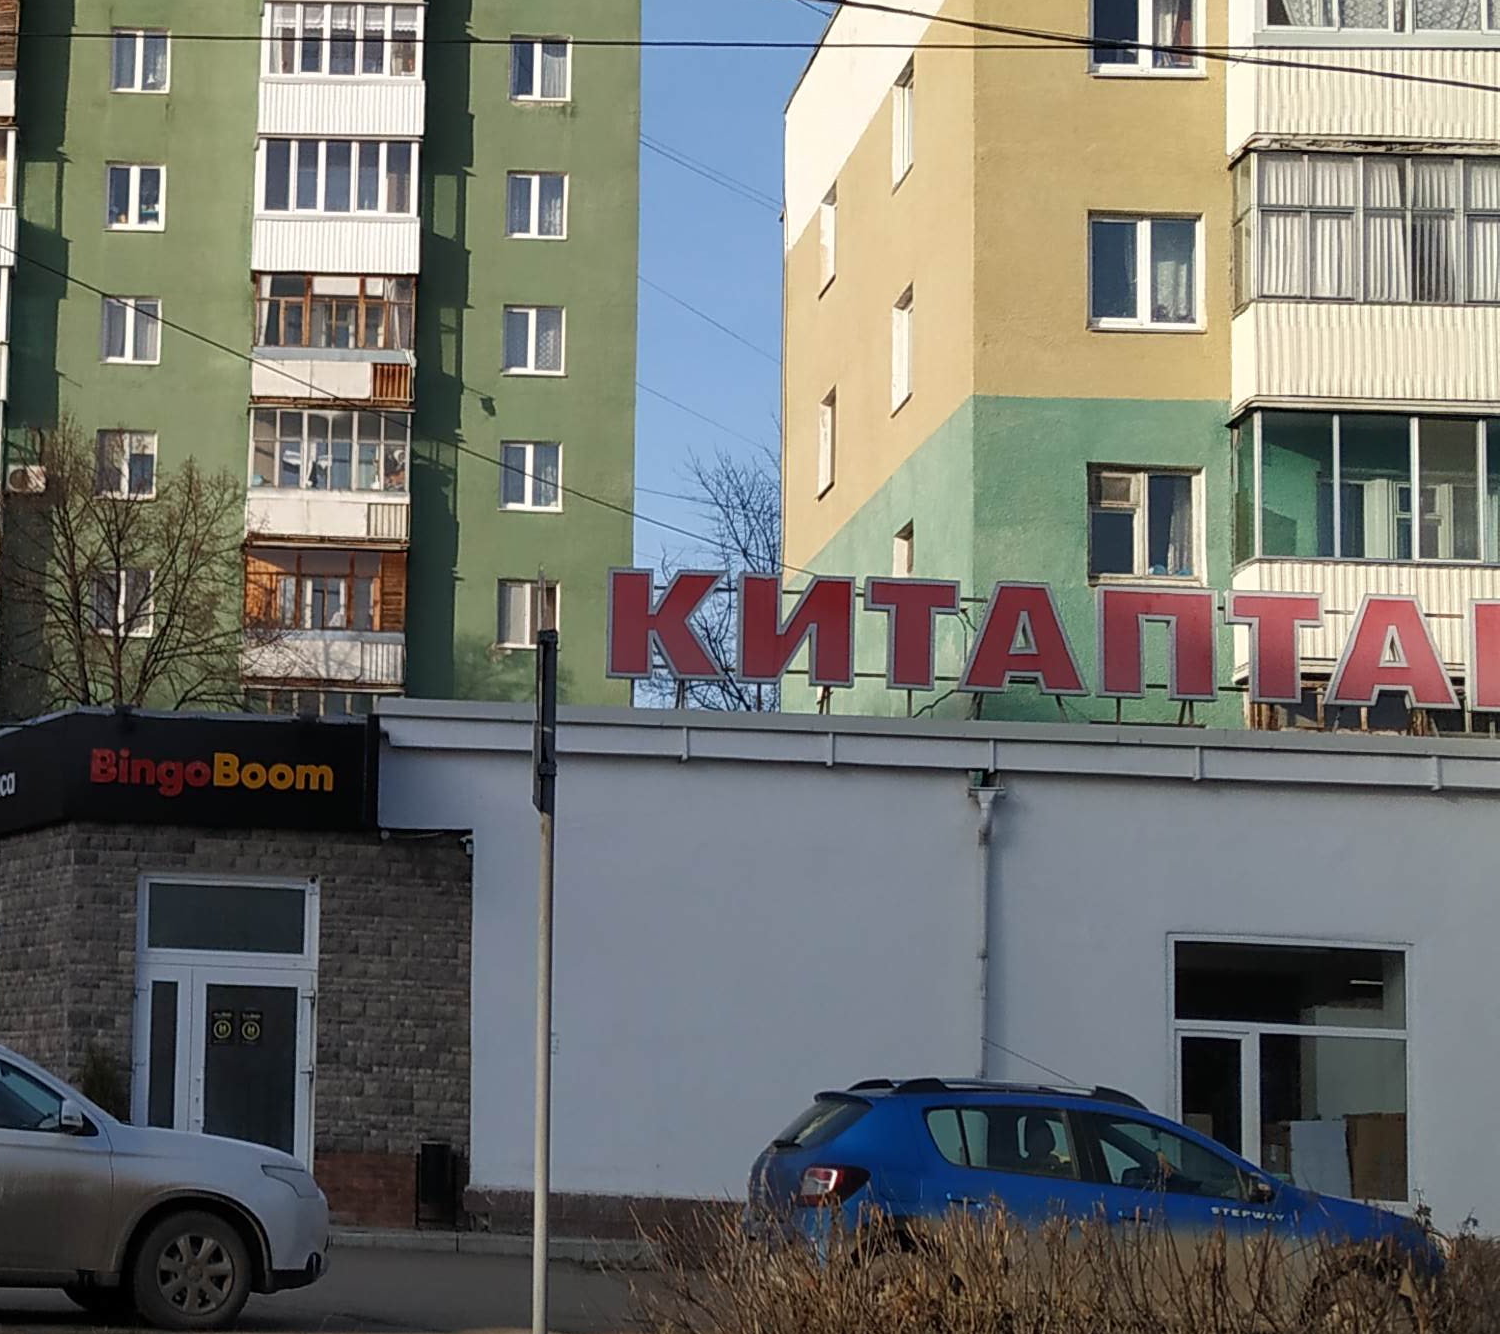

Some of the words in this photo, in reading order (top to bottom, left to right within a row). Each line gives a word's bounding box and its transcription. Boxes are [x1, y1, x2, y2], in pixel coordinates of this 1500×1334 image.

[606, 567, 1500, 711] КИТАПТА
[90, 747, 334, 797] BingoBoom
[1211, 1206, 1285, 1222] STEPWAY
